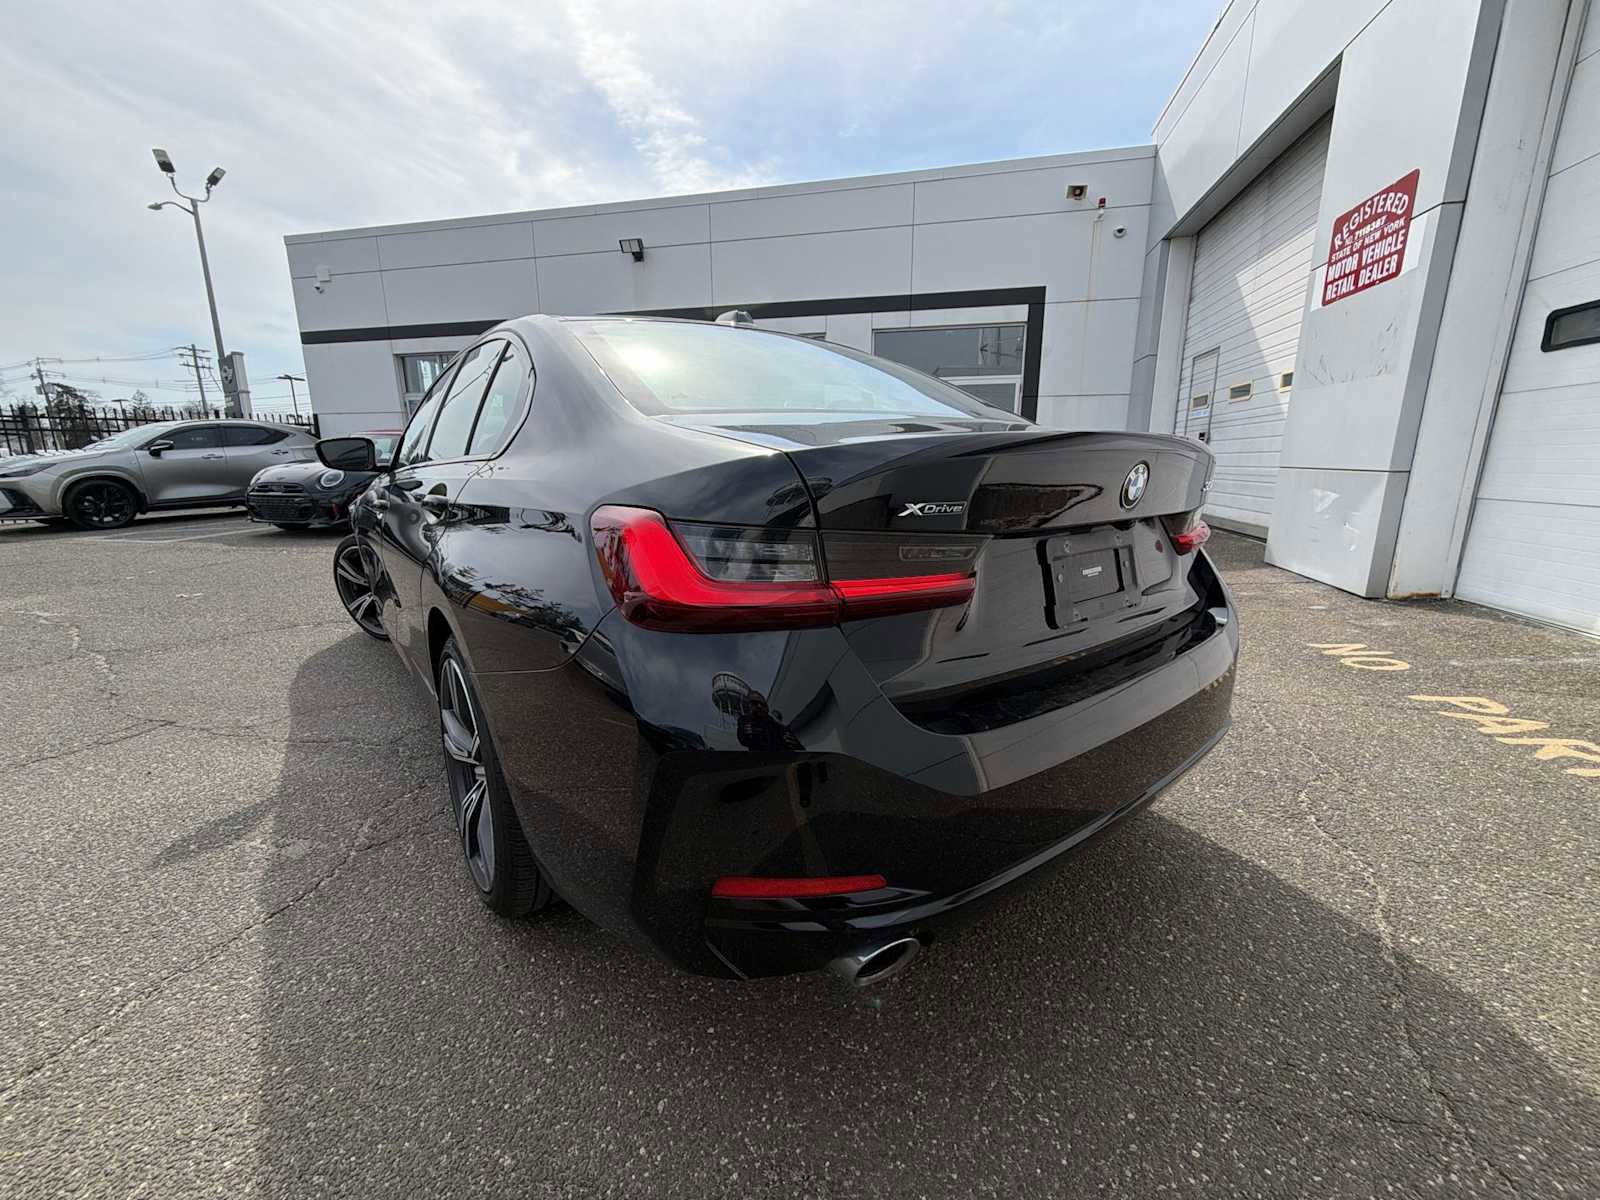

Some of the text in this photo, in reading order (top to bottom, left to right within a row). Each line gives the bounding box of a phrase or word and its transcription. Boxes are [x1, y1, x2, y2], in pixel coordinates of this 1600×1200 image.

[1331, 216, 1406, 263] STATE OF NEW YORK
[1333, 192, 1409, 250] REGISTERED
[1325, 253, 1399, 301] RETAIL DEALER
[1327, 229, 1406, 283] MOTOR VEHICLE
[1306, 643, 1410, 671] NO
